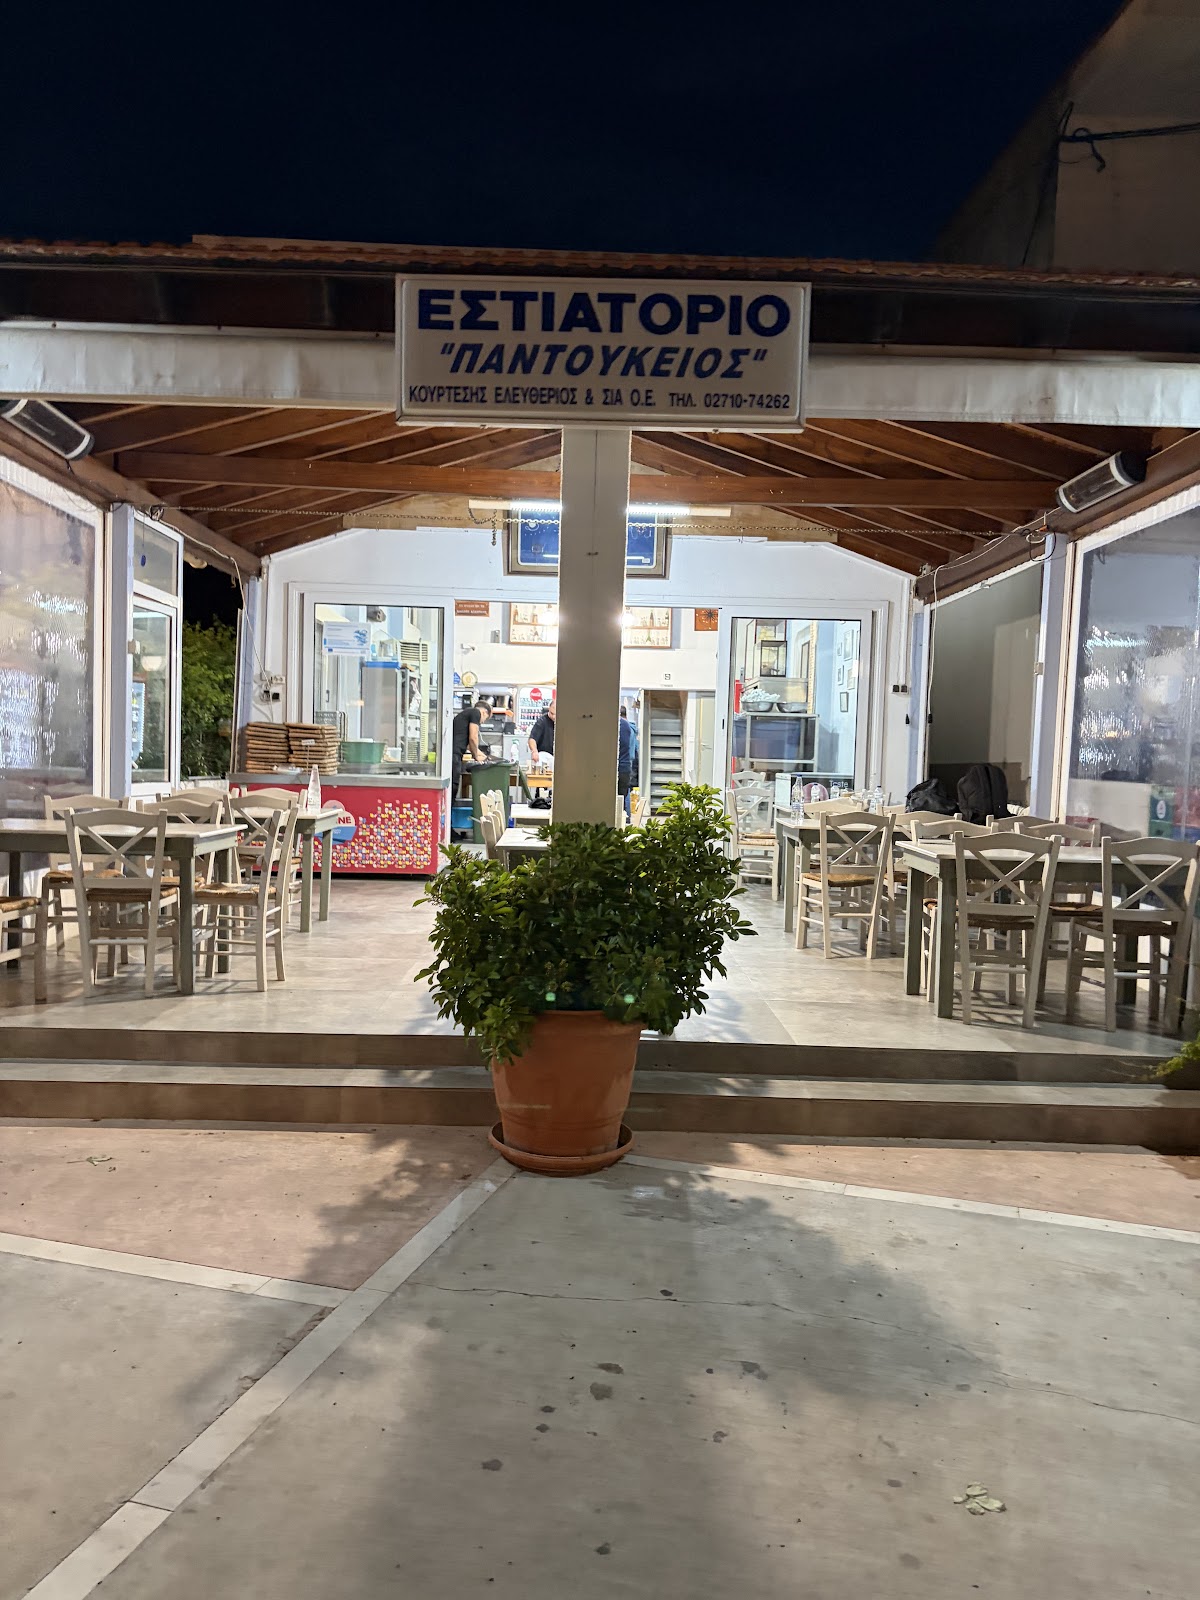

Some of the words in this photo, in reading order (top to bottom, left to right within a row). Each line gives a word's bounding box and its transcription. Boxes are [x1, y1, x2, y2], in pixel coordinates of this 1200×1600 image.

[417, 288, 791, 338] ΕΣΤΙΑΤΟΡΙΟ
[409, 384, 487, 404] ΚΟΥΡΤΕΣΗΣ
[494, 386, 578, 406] ΕΛΕΥΘΕΡΙΟΣ
[584, 388, 594, 406] &
[602, 389, 623, 406] ΣΙΑ
[629, 388, 657, 407] Ο.Ε.
[668, 392, 697, 408] ΤΗΛ.
[703, 393, 790, 409] 02710-74262
[337, 816, 352, 825] NE
